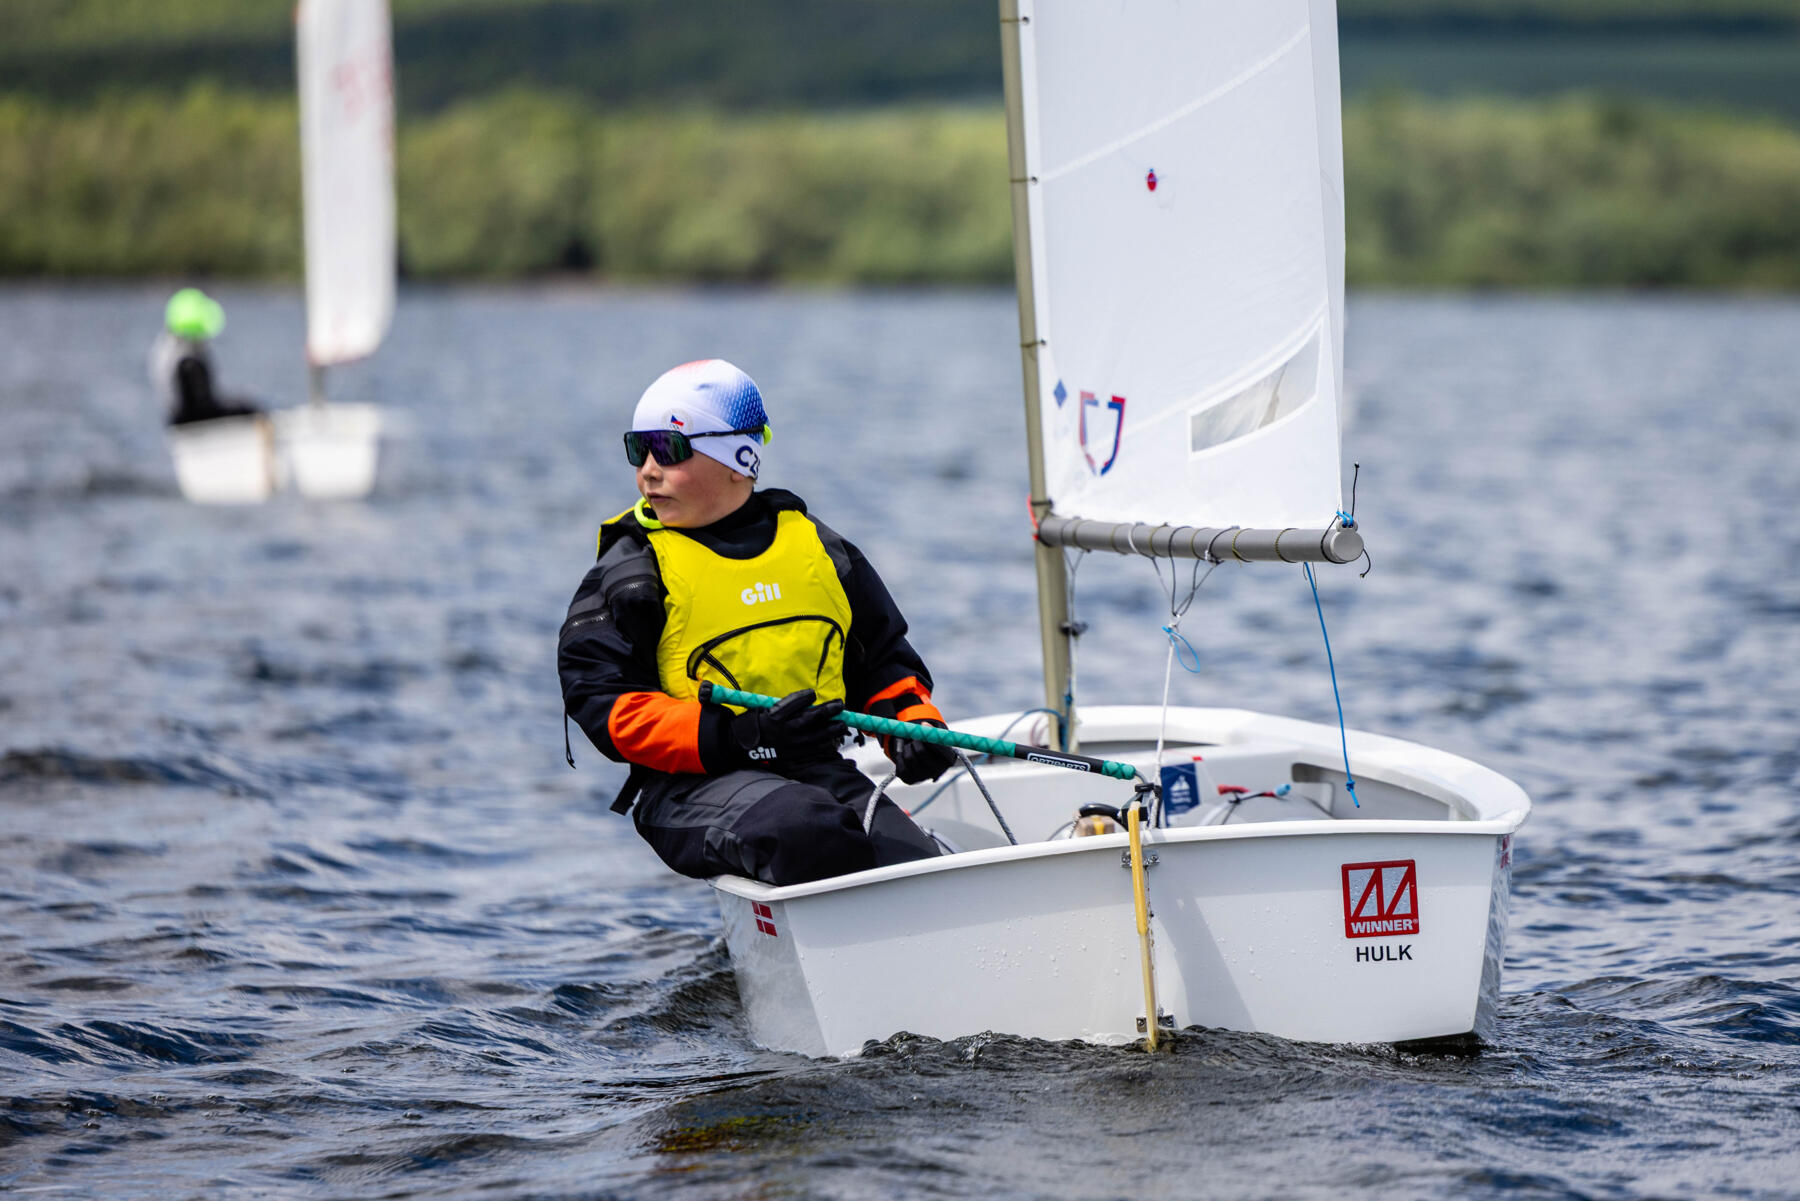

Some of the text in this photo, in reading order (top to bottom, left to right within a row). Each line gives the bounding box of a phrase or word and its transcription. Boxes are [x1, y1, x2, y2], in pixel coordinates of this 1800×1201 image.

[741, 582, 781, 605] Gill
[749, 746, 777, 760] Gill
[1356, 944, 1413, 962] HULK
